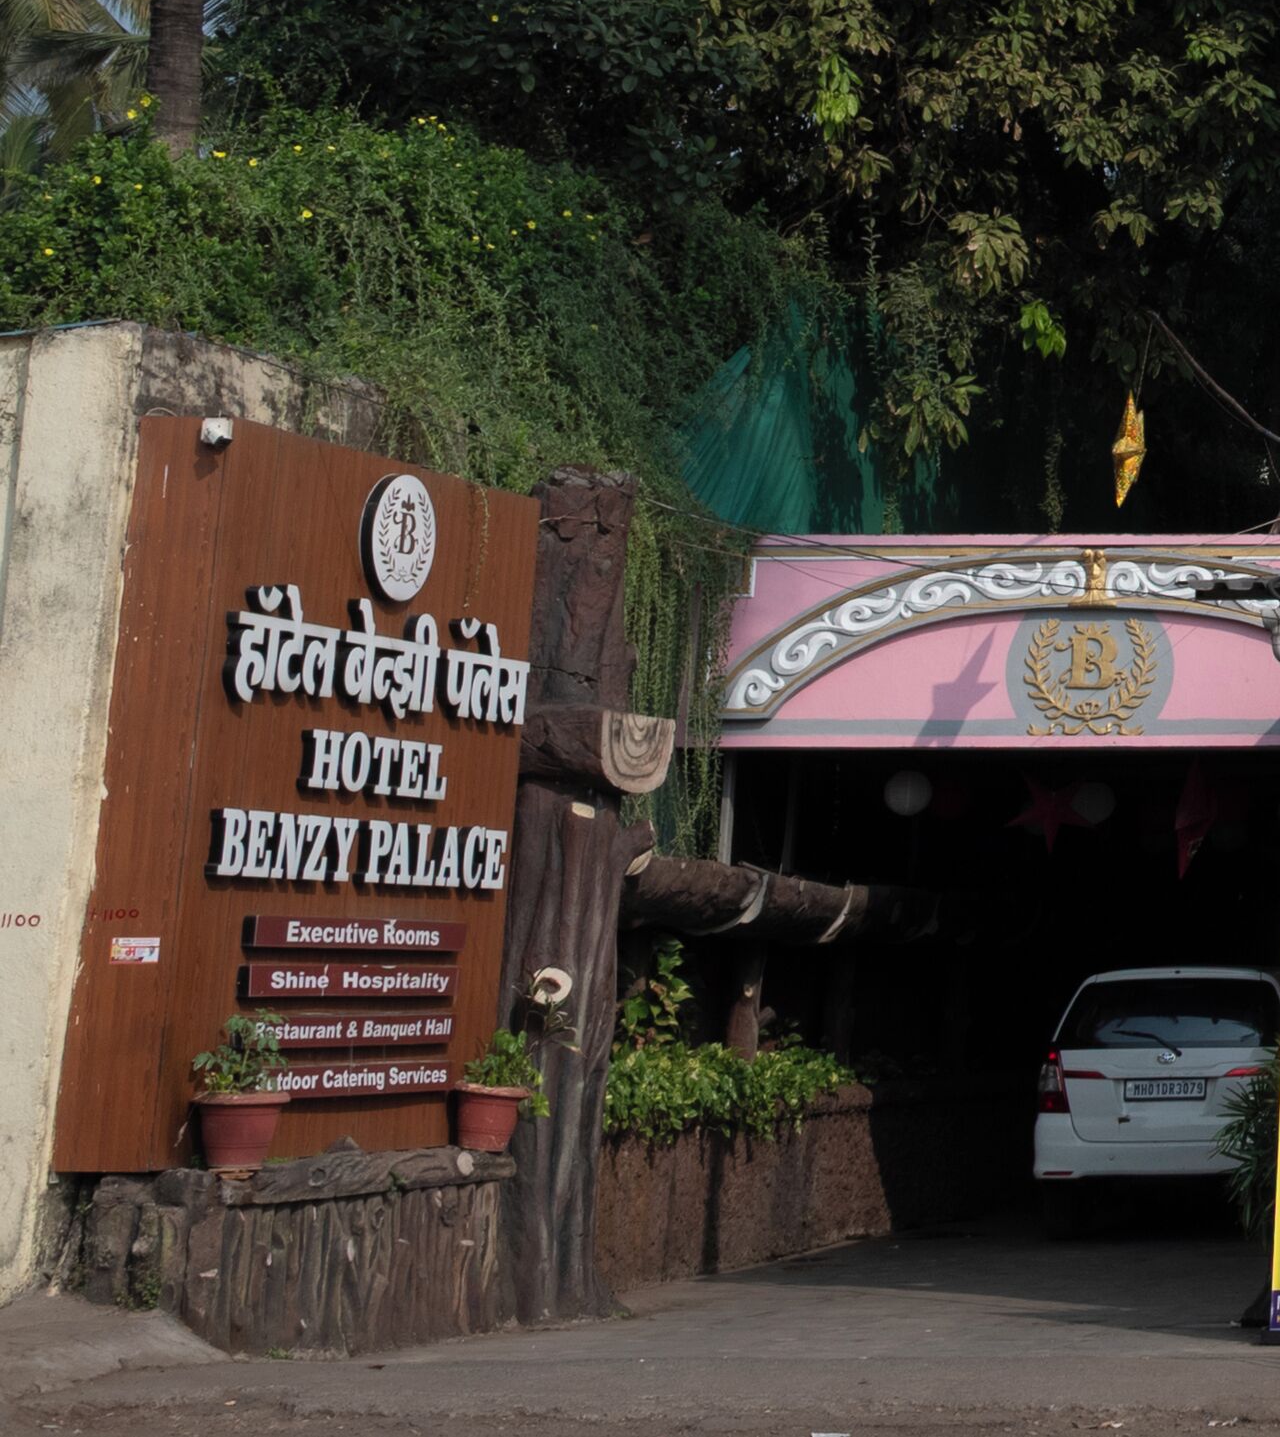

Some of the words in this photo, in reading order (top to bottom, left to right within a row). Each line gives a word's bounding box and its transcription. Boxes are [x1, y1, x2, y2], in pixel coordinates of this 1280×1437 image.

[308, 729, 447, 800] HOTEL
[217, 808, 360, 882] BENZY
[364, 820, 508, 890] PALACE
[286, 921, 378, 945] Executive
[384, 922, 439, 946] Rooms
[271, 971, 329, 989] Shine
[343, 971, 449, 992] Hospitality
[346, 1020, 358, 1038] &
[363, 1020, 422, 1041] Banquet
[425, 1018, 452, 1035] Hall
[323, 1068, 385, 1090] Catering
[389, 1066, 447, 1085] Services
